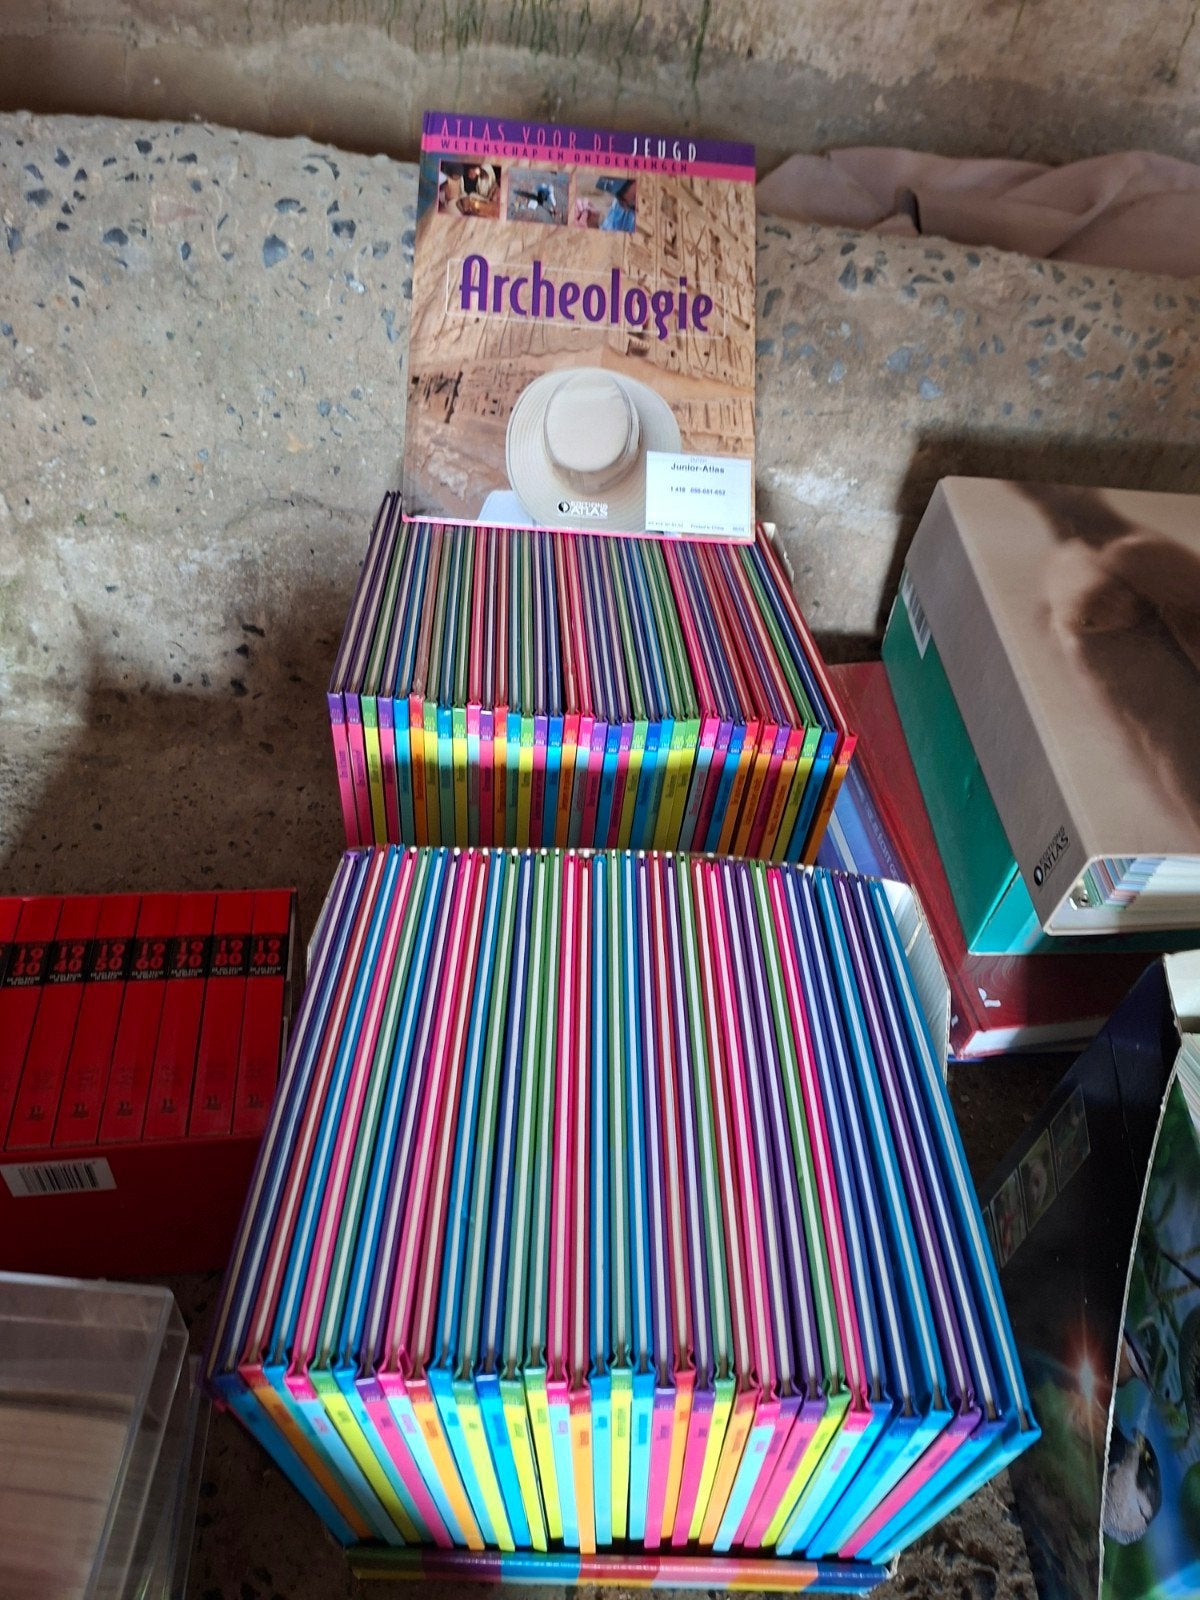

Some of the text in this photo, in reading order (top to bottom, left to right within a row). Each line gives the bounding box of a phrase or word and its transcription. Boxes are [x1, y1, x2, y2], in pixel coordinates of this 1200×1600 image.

[441, 118, 697, 163] ATLAS VOOR DE JEUGD
[441, 138, 687, 173] WETENSCHAP EN ONTDEKKINGEN
[459, 254, 713, 340] Archeologie
[670, 462, 725, 474] Junior-Atlas
[571, 506, 608, 517] ATLAS
[1044, 836, 1069, 877] ATLAS
[60, 945, 85, 958] 19
[101, 943, 125, 957] 19
[142, 942, 165, 955] 19
[180, 940, 204, 954] 19
[220, 939, 243, 952] 19
[258, 939, 280, 952] 19
[18, 948, 43, 960] 19
[54, 958, 81, 973] 40
